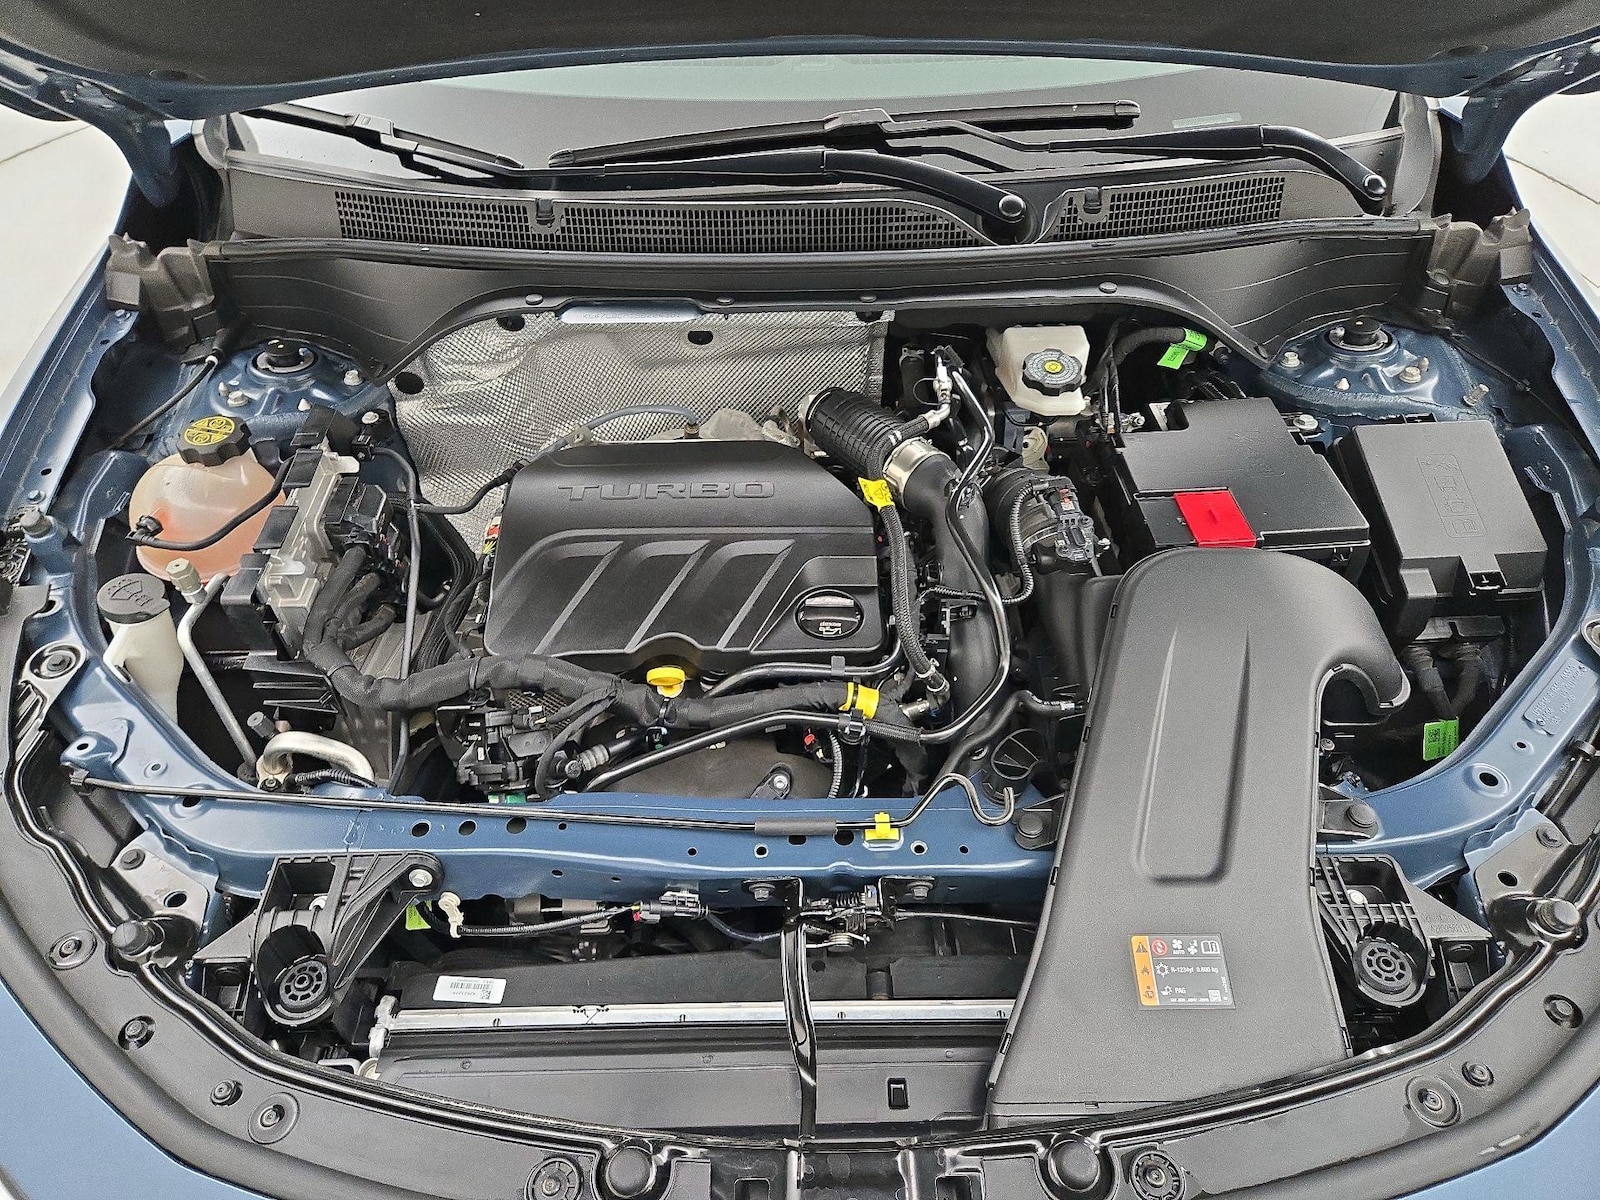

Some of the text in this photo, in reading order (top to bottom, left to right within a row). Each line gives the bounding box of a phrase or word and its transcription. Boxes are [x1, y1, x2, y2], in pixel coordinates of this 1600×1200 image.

[557, 481, 775, 501] TURBO
[1170, 966, 1194, 974] R-1234yf
[1211, 966, 1219, 974] kg
